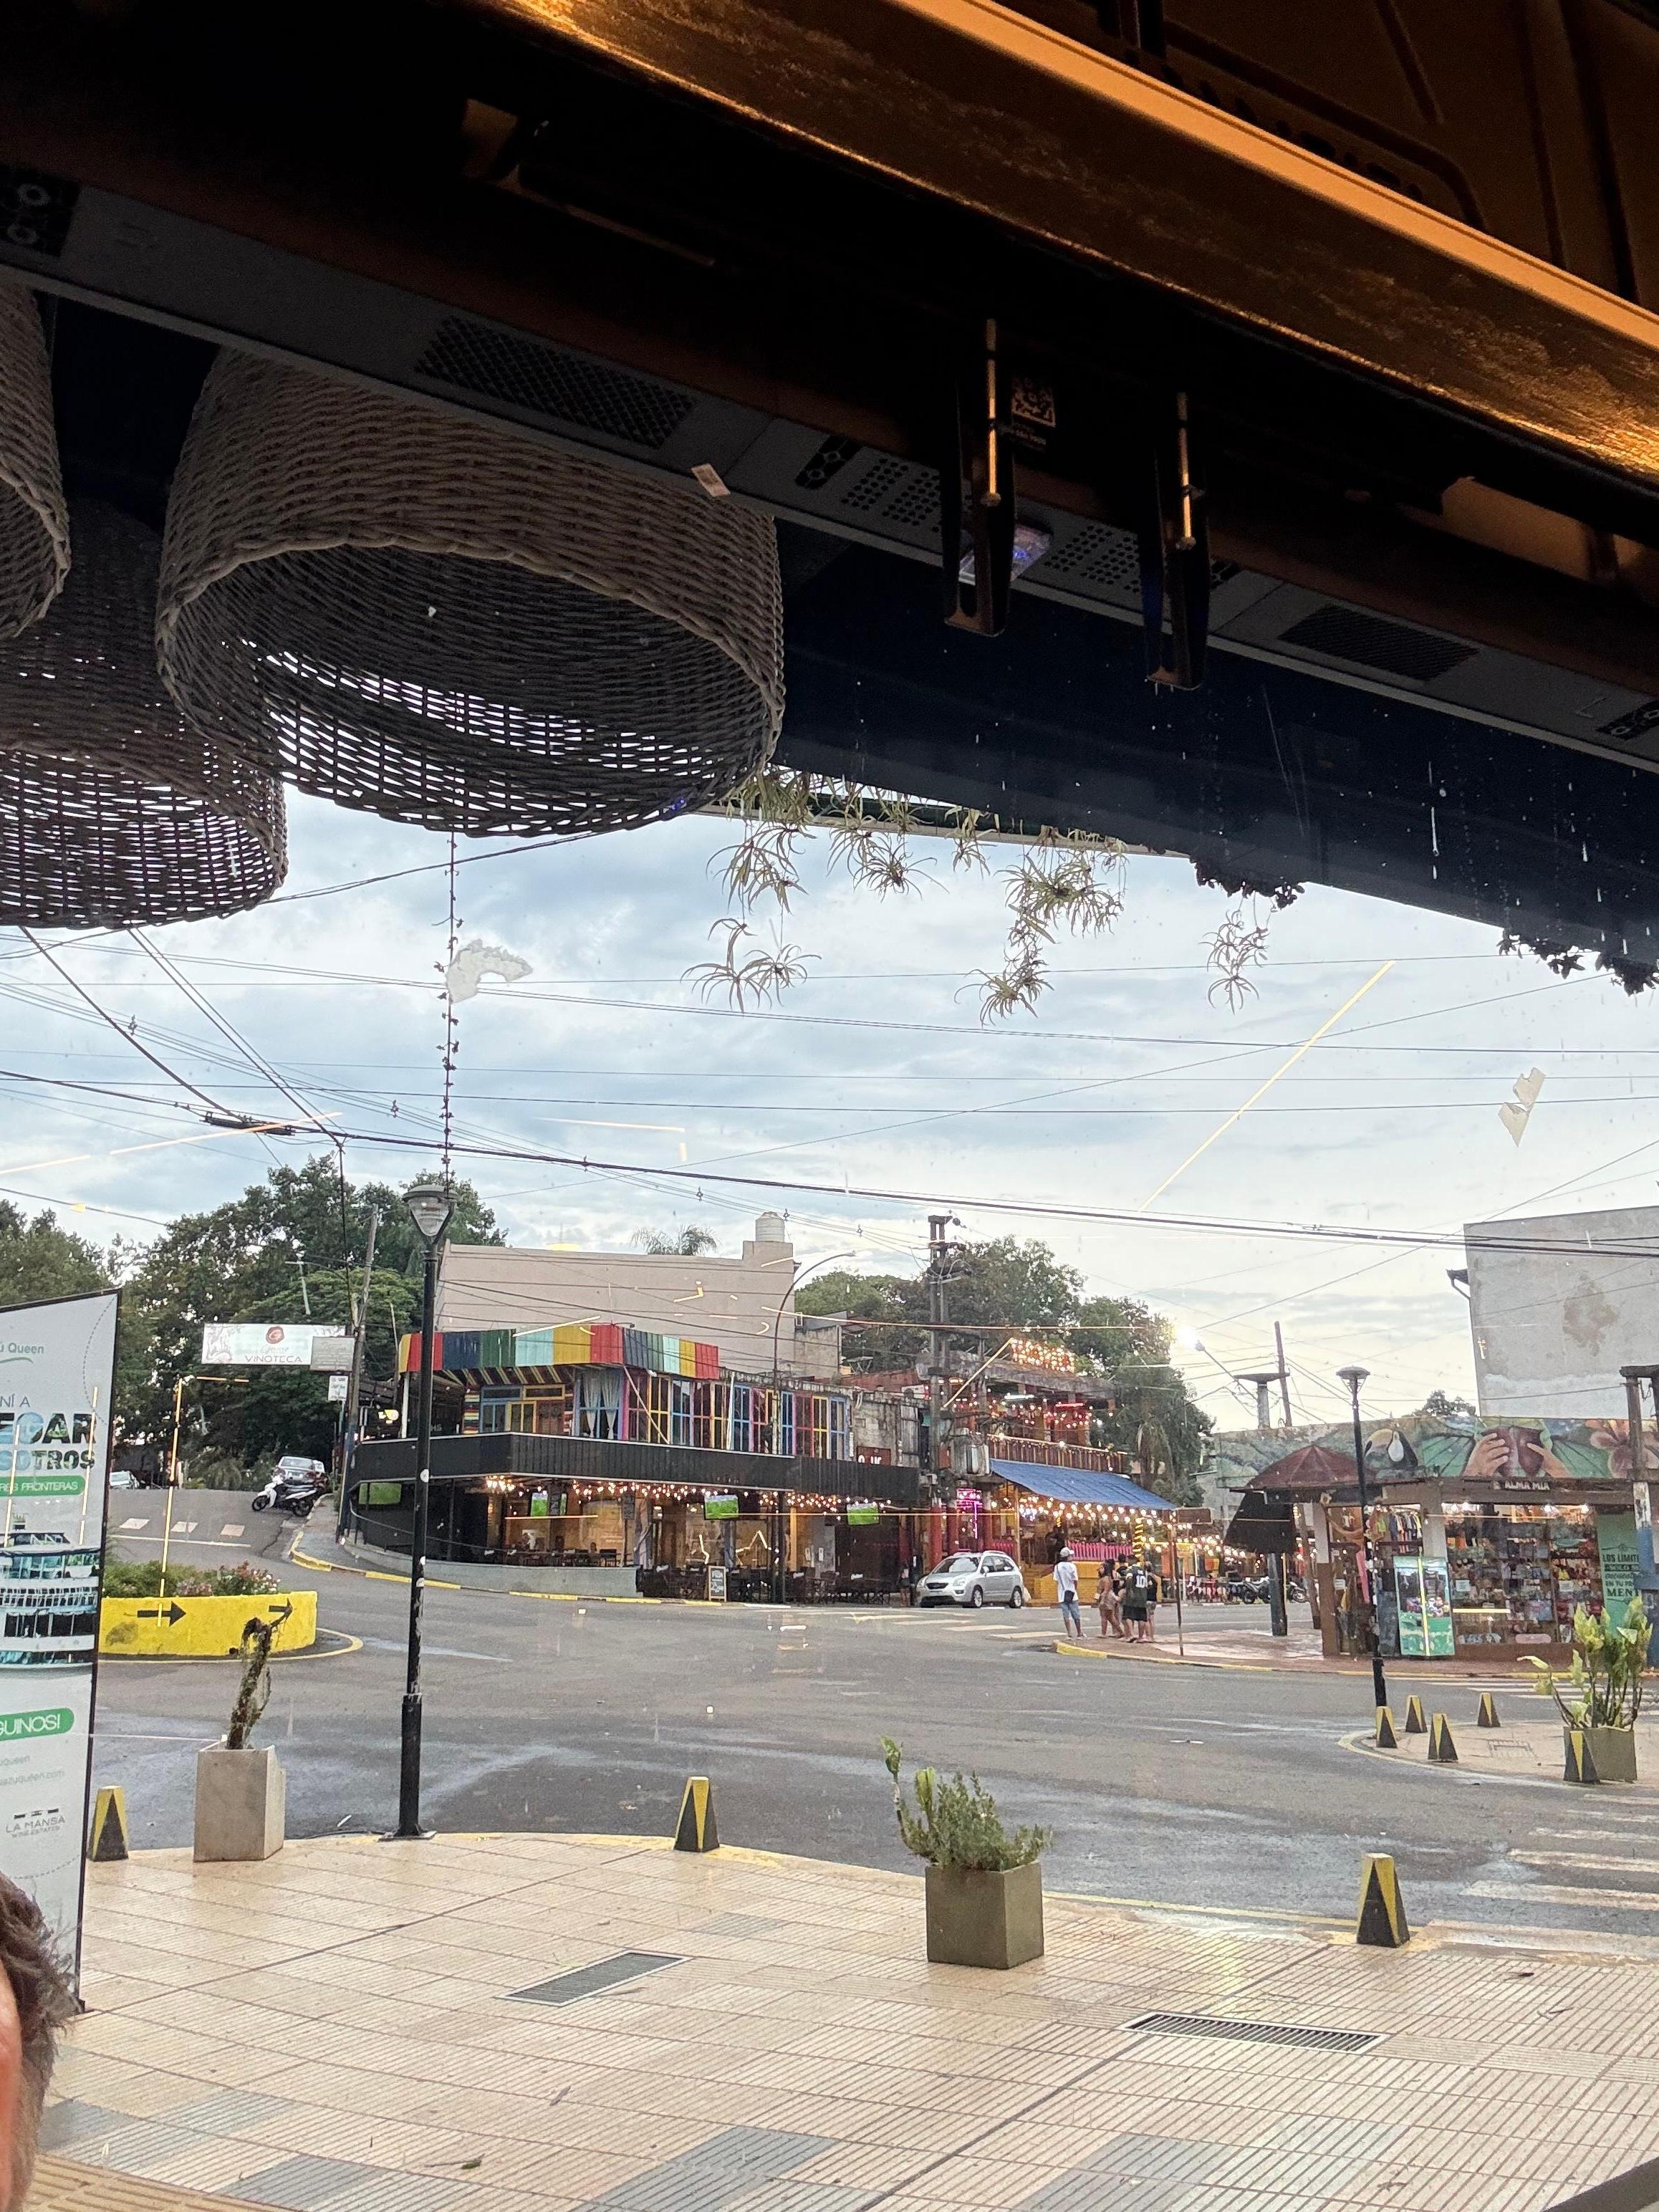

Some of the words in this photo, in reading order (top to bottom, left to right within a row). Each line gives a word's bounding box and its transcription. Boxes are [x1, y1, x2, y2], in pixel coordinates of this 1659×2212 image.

[8, 1342, 44, 1354] Queen
[19, 1396, 30, 1408] A
[21, 1481, 78, 1491] FRONTERAS
[1135, 1574, 1145, 1588] 10
[6, 1822, 21, 1833] LA
[24, 1814, 66, 1828] MANSA
